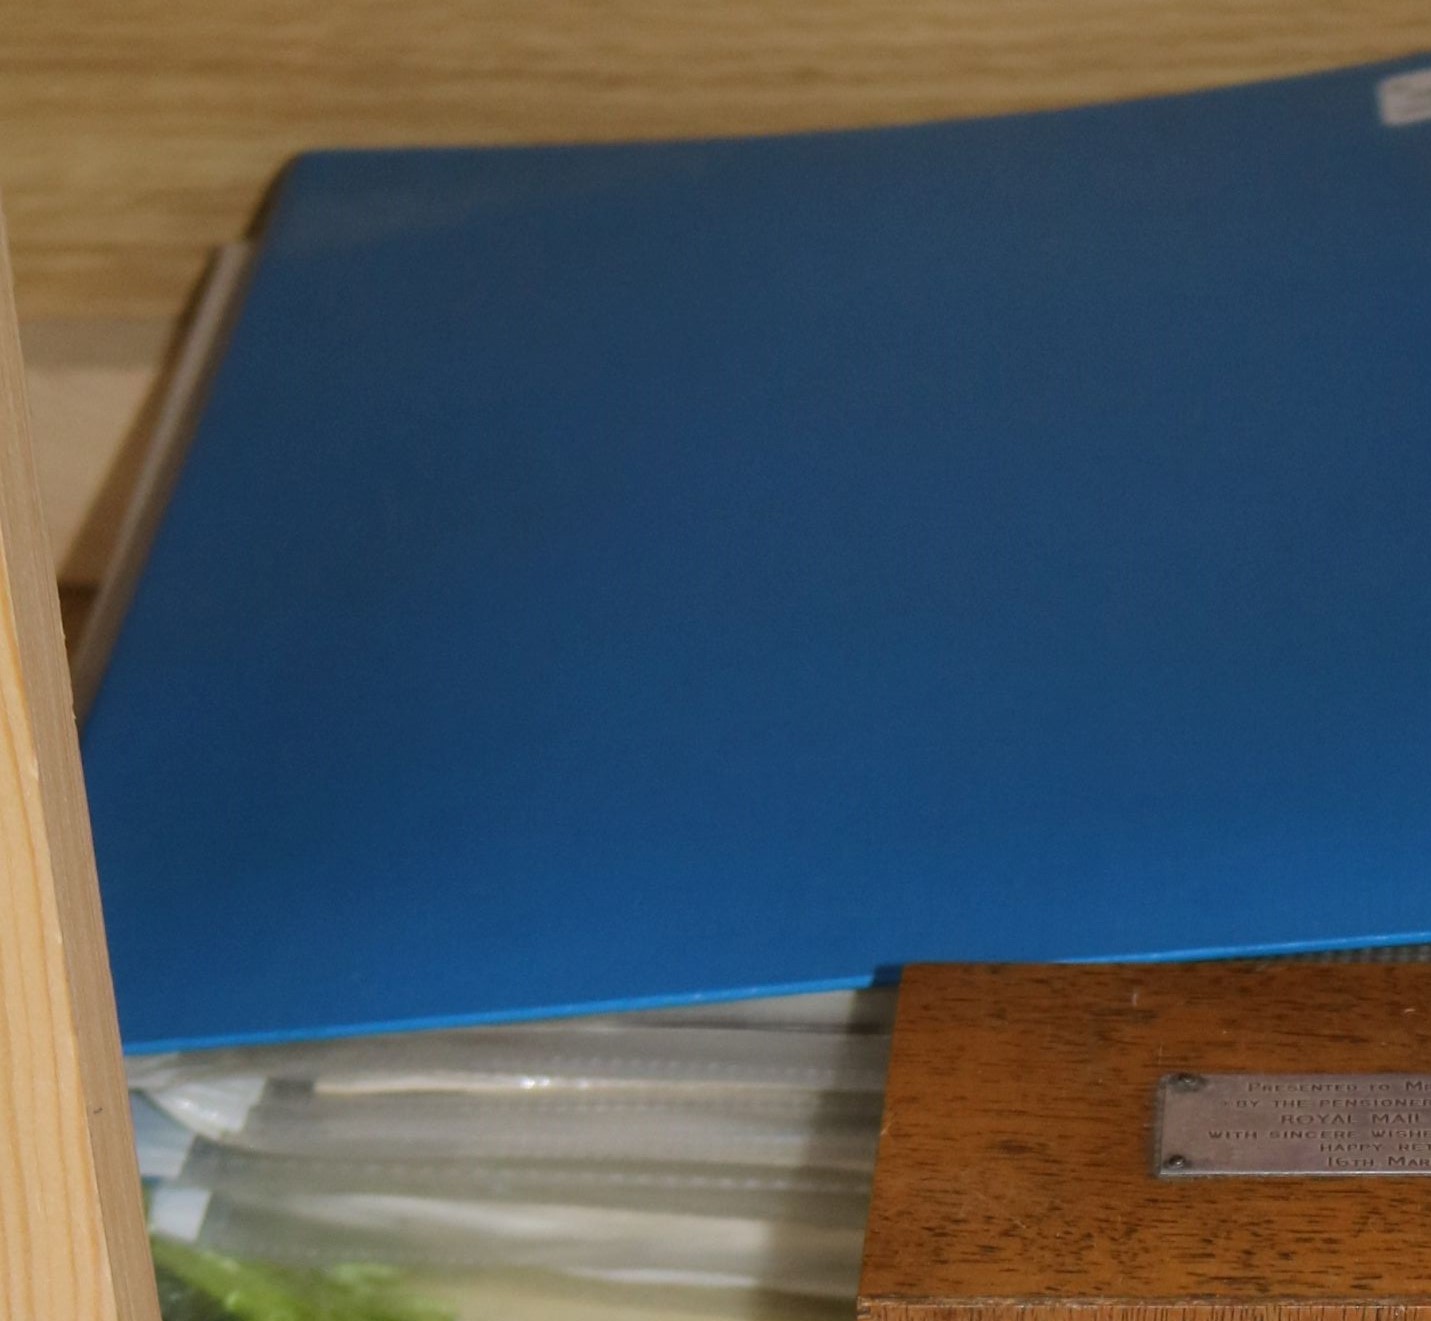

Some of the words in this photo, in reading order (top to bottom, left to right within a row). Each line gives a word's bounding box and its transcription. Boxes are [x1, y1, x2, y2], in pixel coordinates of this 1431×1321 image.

[1275, 1099, 1310, 1108] THE
[1281, 1114, 1358, 1125] ROYAL
[1372, 1113, 1421, 1125] MAIL
[1209, 1131, 1258, 1140] WITH
[1270, 1131, 1358, 1140] SINCERE
[1320, 1144, 1383, 1153] HAPPY
